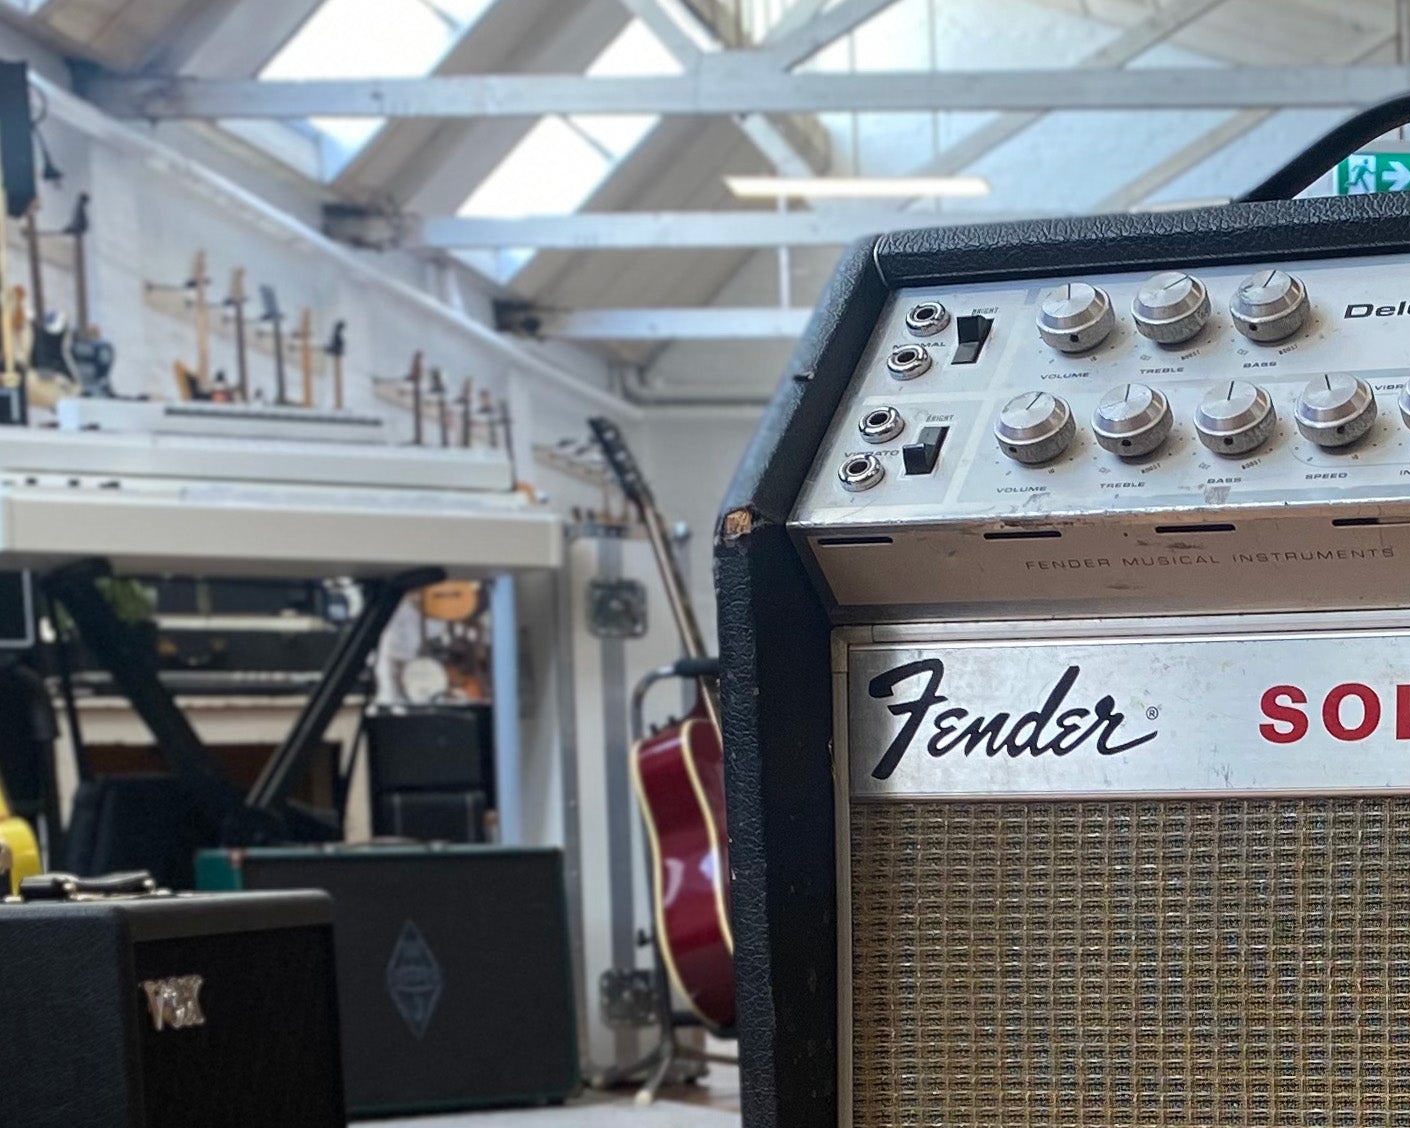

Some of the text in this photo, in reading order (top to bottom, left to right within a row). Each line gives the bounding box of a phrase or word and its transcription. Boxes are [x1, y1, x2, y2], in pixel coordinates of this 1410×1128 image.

[892, 342, 946, 350] NMAL
[1139, 367, 1185, 375] TREBLE
[1040, 372, 1090, 380] VOLUME
[1305, 472, 1348, 480] SPEED
[1100, 481, 1146, 489] TREBLE
[1025, 546, 1395, 570] FENDER MUSICAL INSTRUMENTS
[868, 658, 1159, 781] Fender
